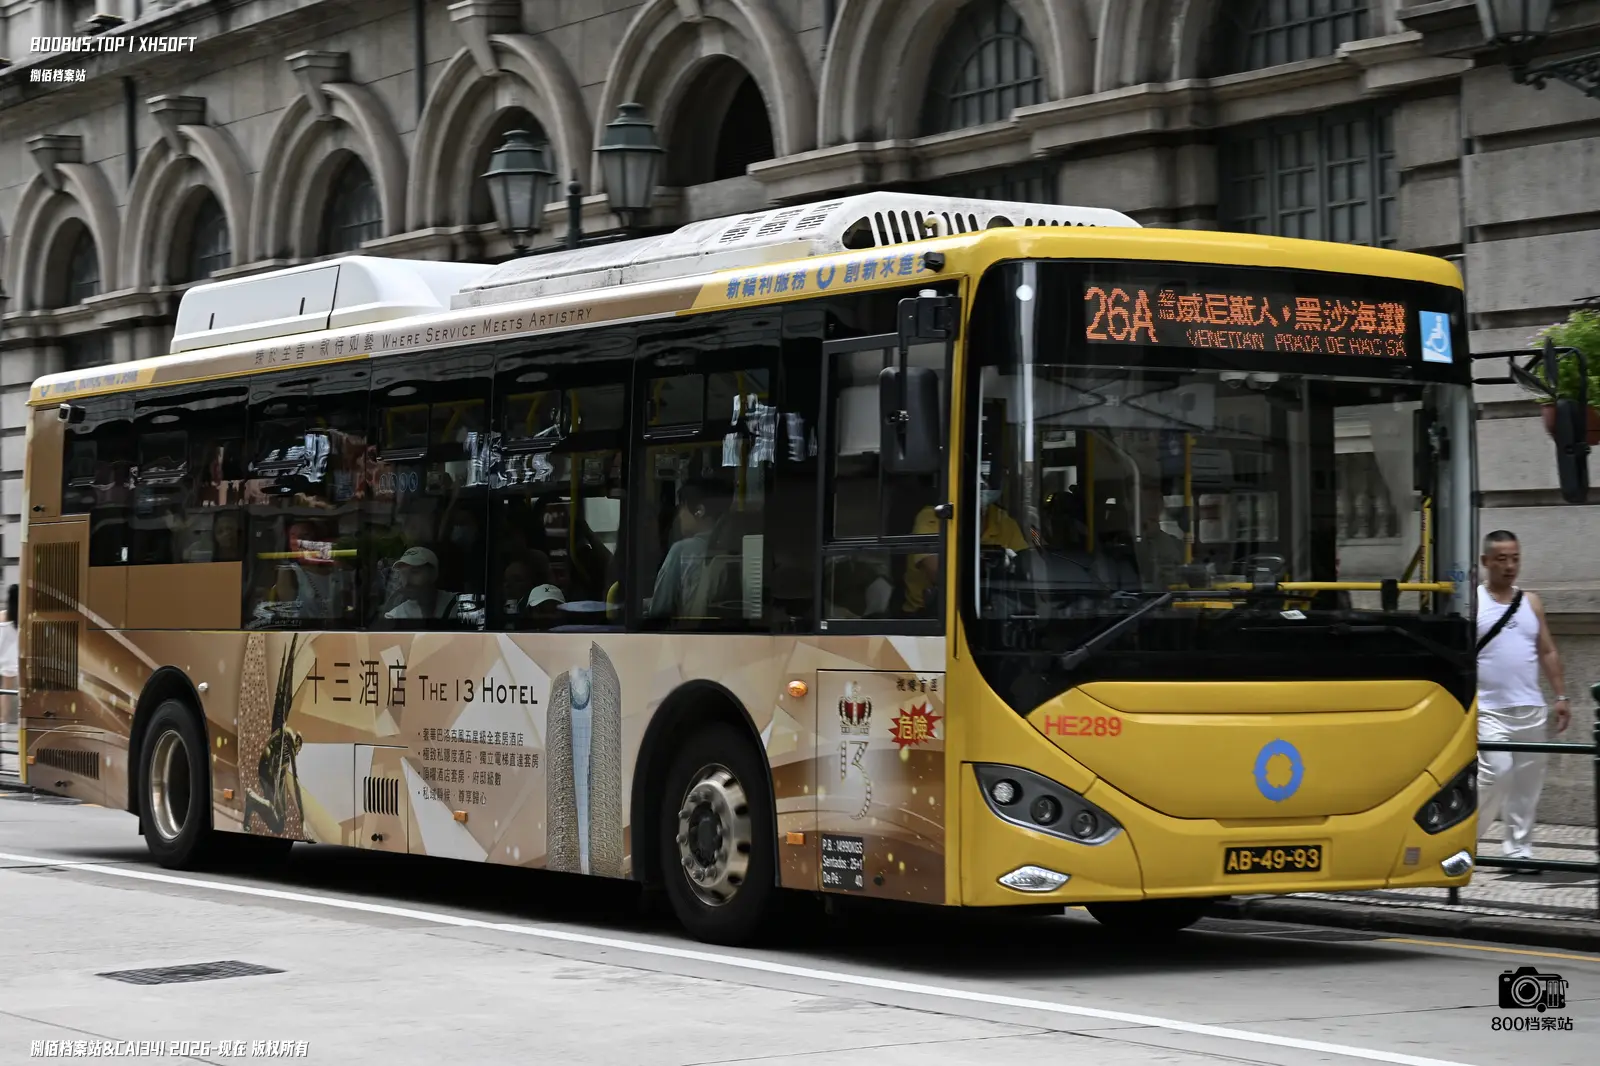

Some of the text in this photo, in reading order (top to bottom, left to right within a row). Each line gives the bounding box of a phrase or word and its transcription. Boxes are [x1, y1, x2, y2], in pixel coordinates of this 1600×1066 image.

[1084, 286, 1158, 343] 26A
[1176, 293, 1280, 328] 威尼斯人
[1294, 297, 1407, 336] 黑沙海灘
[381, 332, 421, 349] WHERE
[425, 323, 477, 342] SERVICE
[482, 316, 523, 333] MEETS
[529, 307, 594, 327] ARTISTRY
[1186, 329, 1265, 350] VENETIAN
[1326, 336, 1346, 354] DE
[306, 657, 539, 708] 十三酒店 THE 13 HOTEL
[898, 714, 929, 740] 危險
[1044, 714, 1123, 737] HE289
[1227, 848, 1320, 871] AB-49-93
